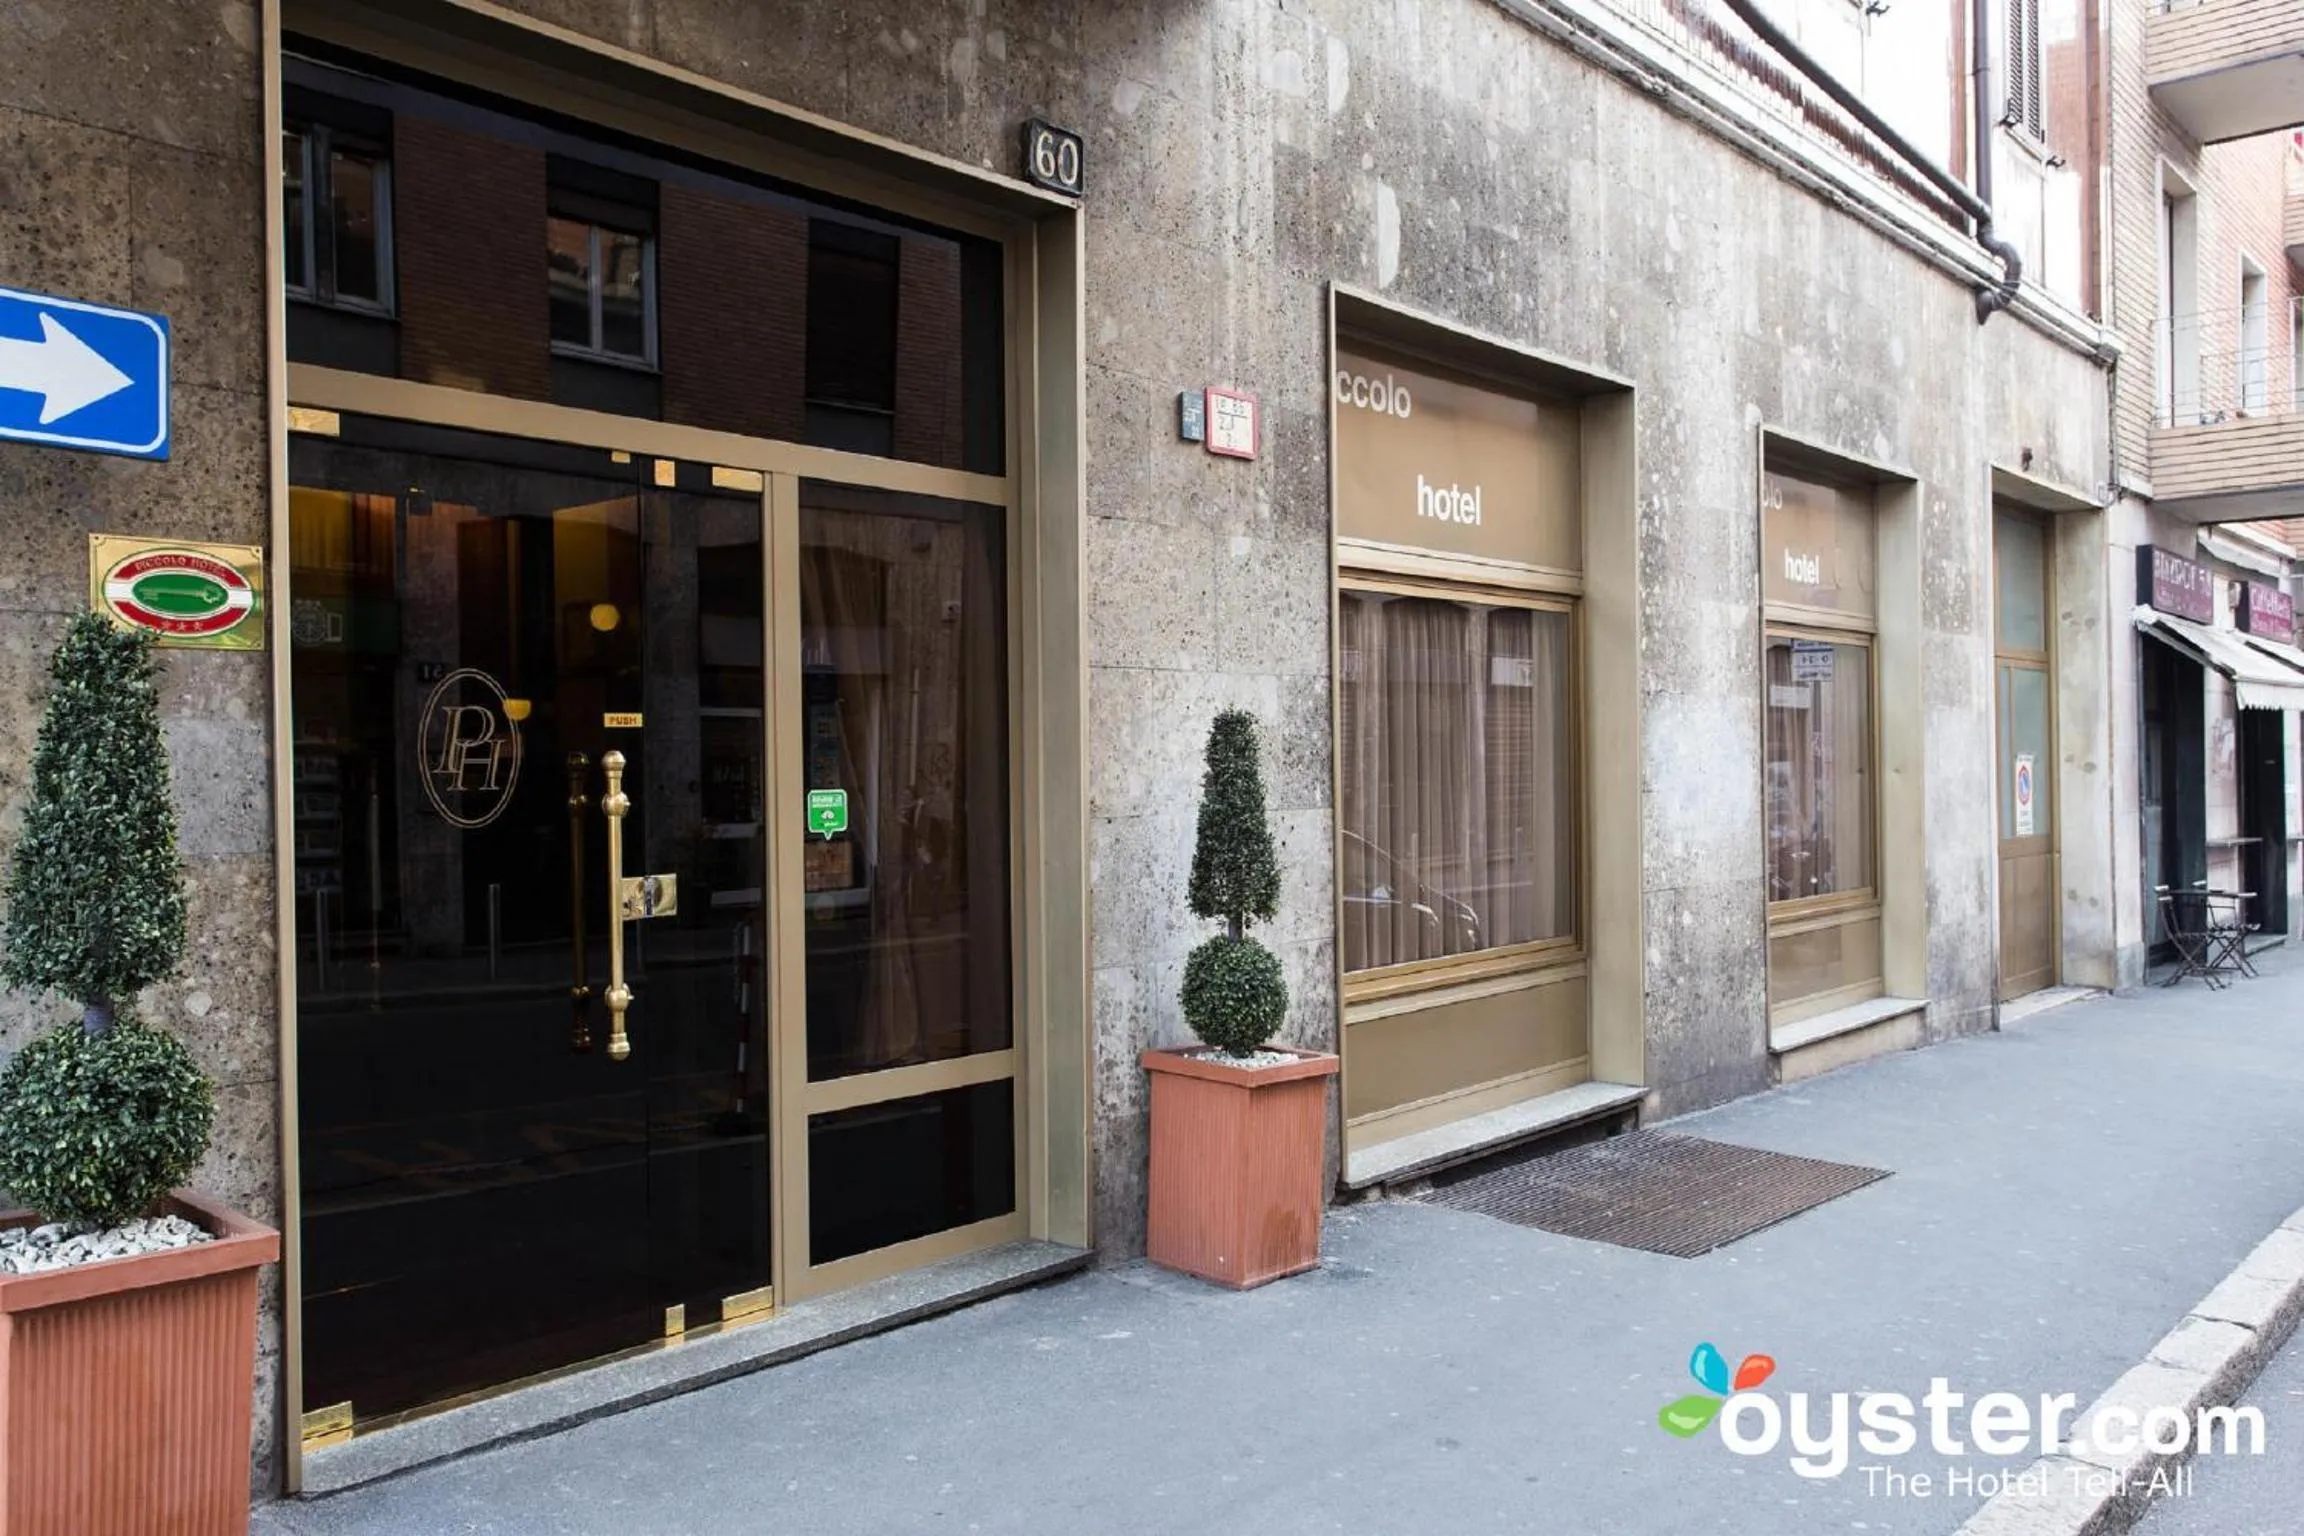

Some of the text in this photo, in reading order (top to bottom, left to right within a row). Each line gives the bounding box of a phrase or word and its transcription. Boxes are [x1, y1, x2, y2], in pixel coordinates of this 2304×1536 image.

[1035, 130, 1079, 186] 60
[1336, 370, 1412, 419] ccolo
[1416, 473, 1482, 526] hotel
[135, 555, 227, 579] PICCOLO HOTEL
[1784, 547, 1821, 585] hotel
[607, 716, 638, 726] PUSH
